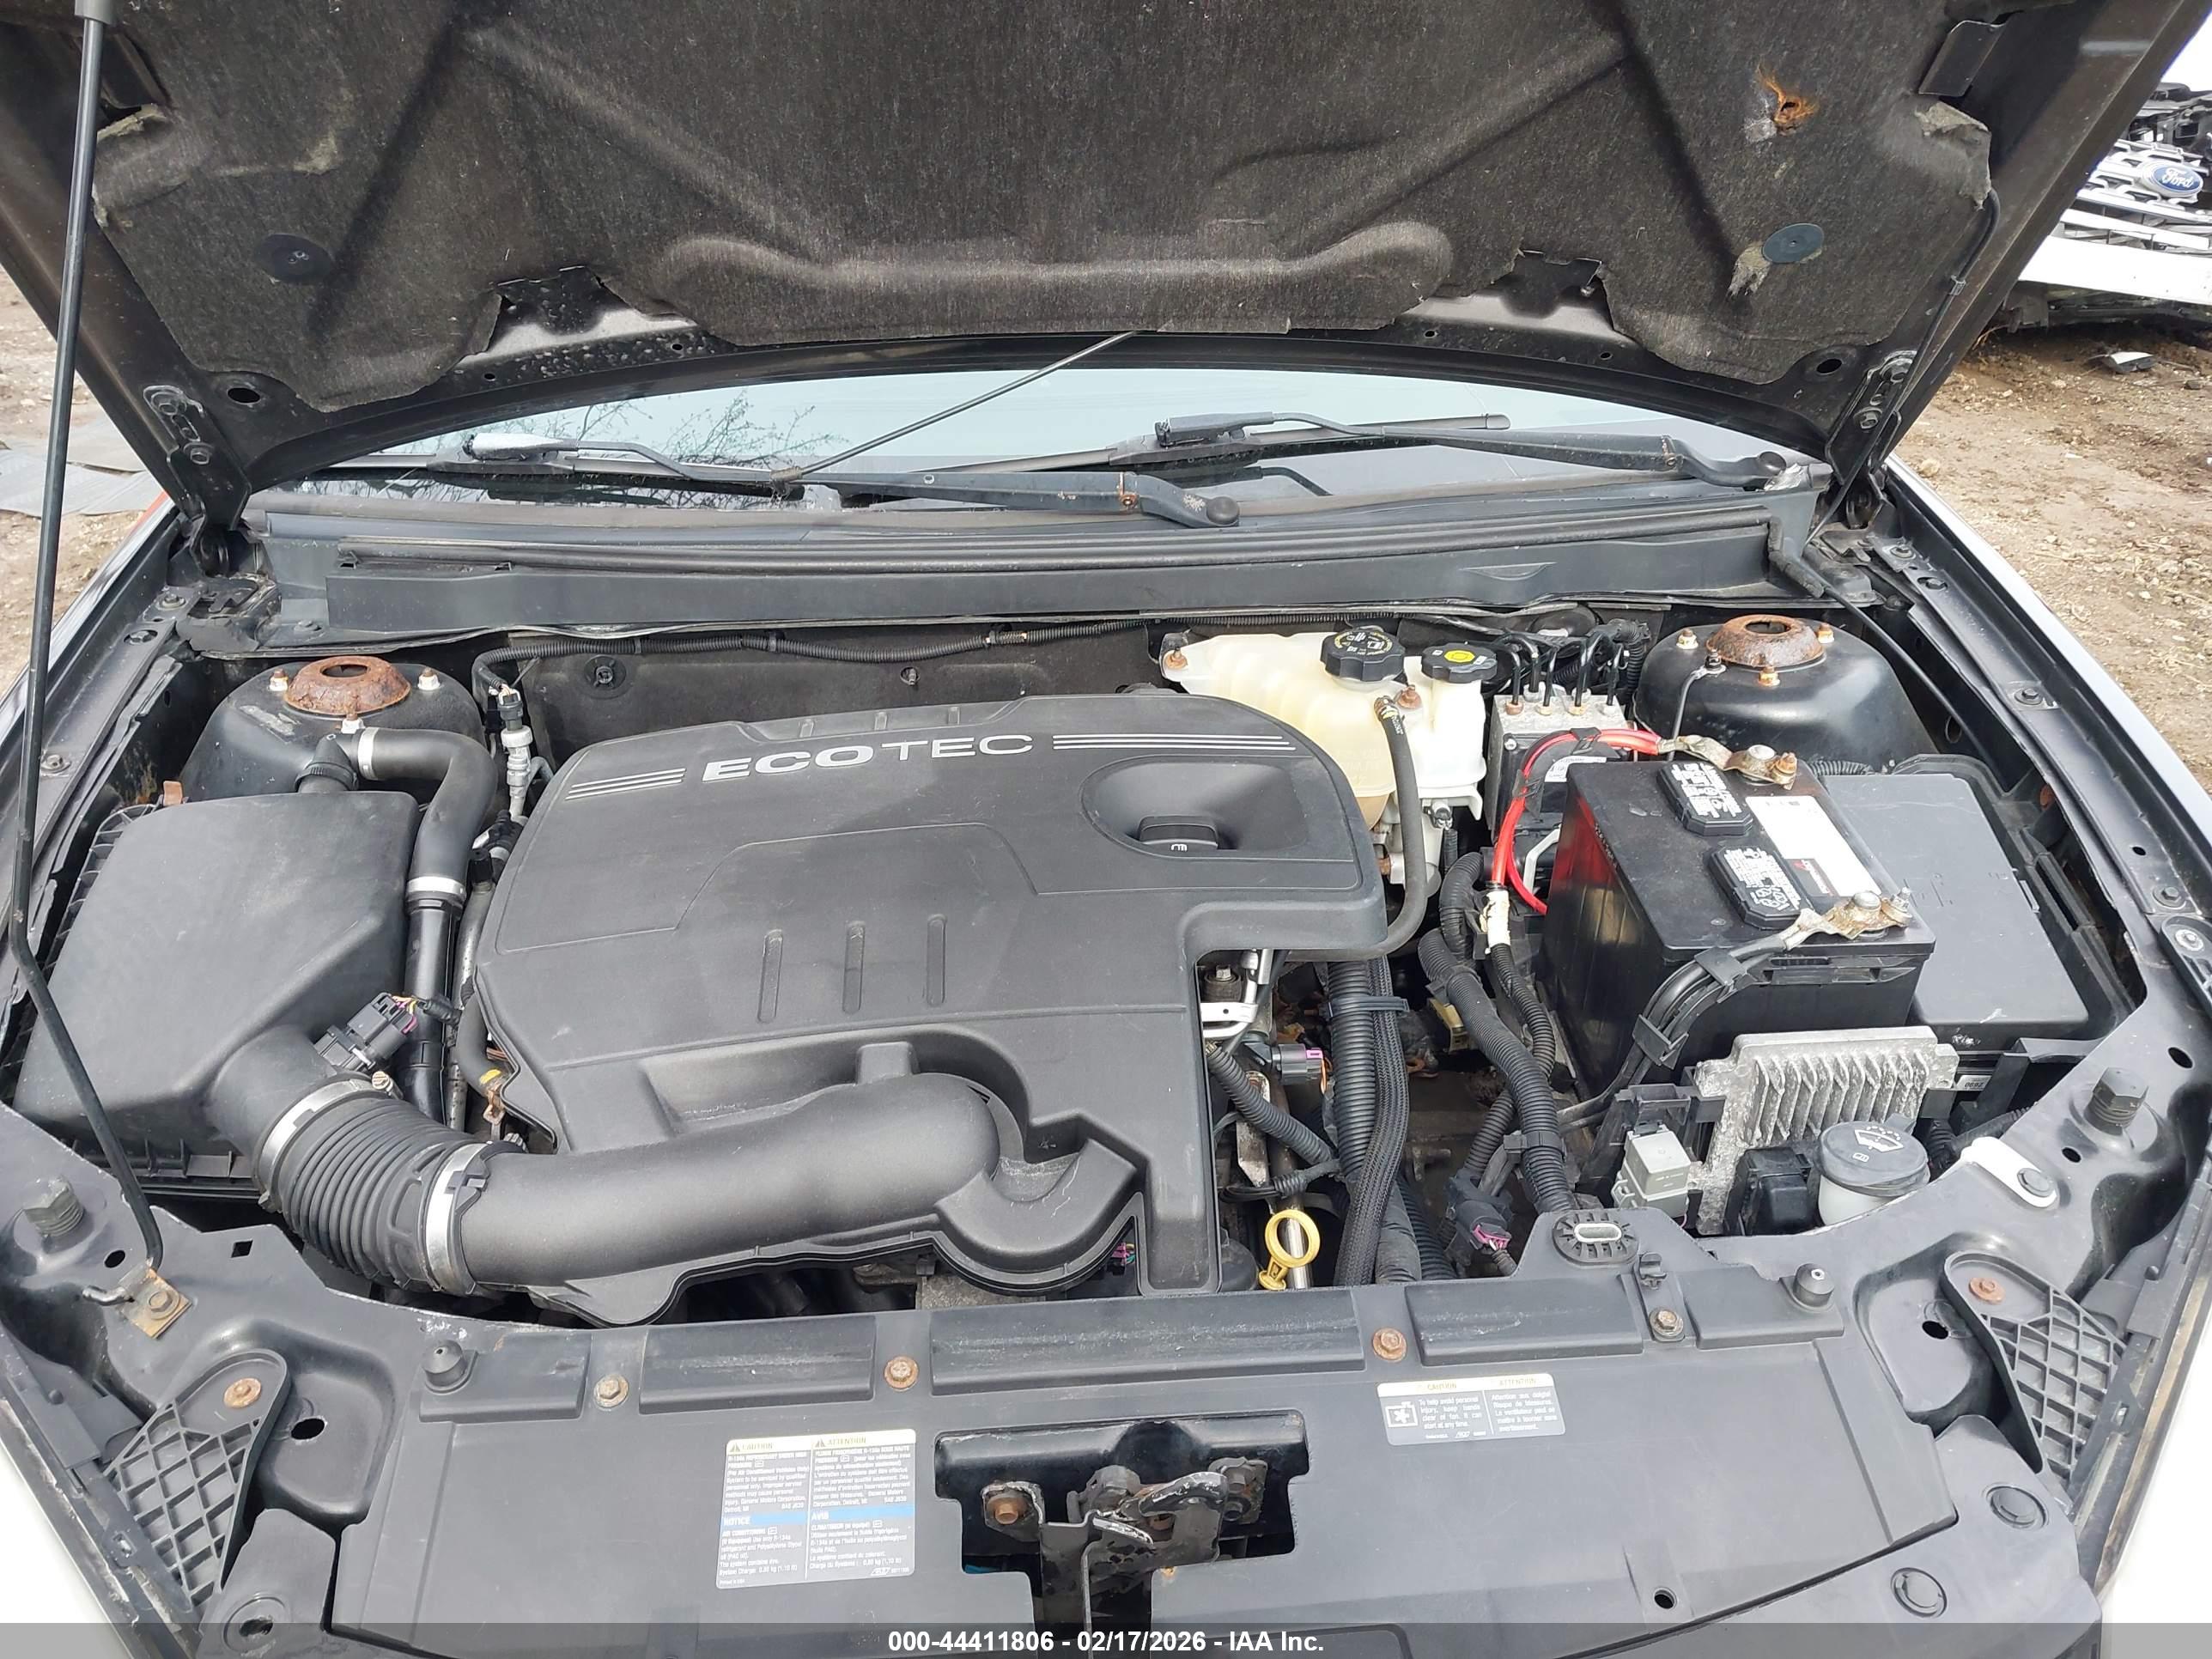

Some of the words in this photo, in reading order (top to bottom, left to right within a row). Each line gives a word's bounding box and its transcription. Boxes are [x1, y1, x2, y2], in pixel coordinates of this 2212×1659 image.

[2162, 167, 2195, 188] Ford
[702, 734, 1032, 782] ECOTEC
[723, 1516, 750, 1526] NOTICE
